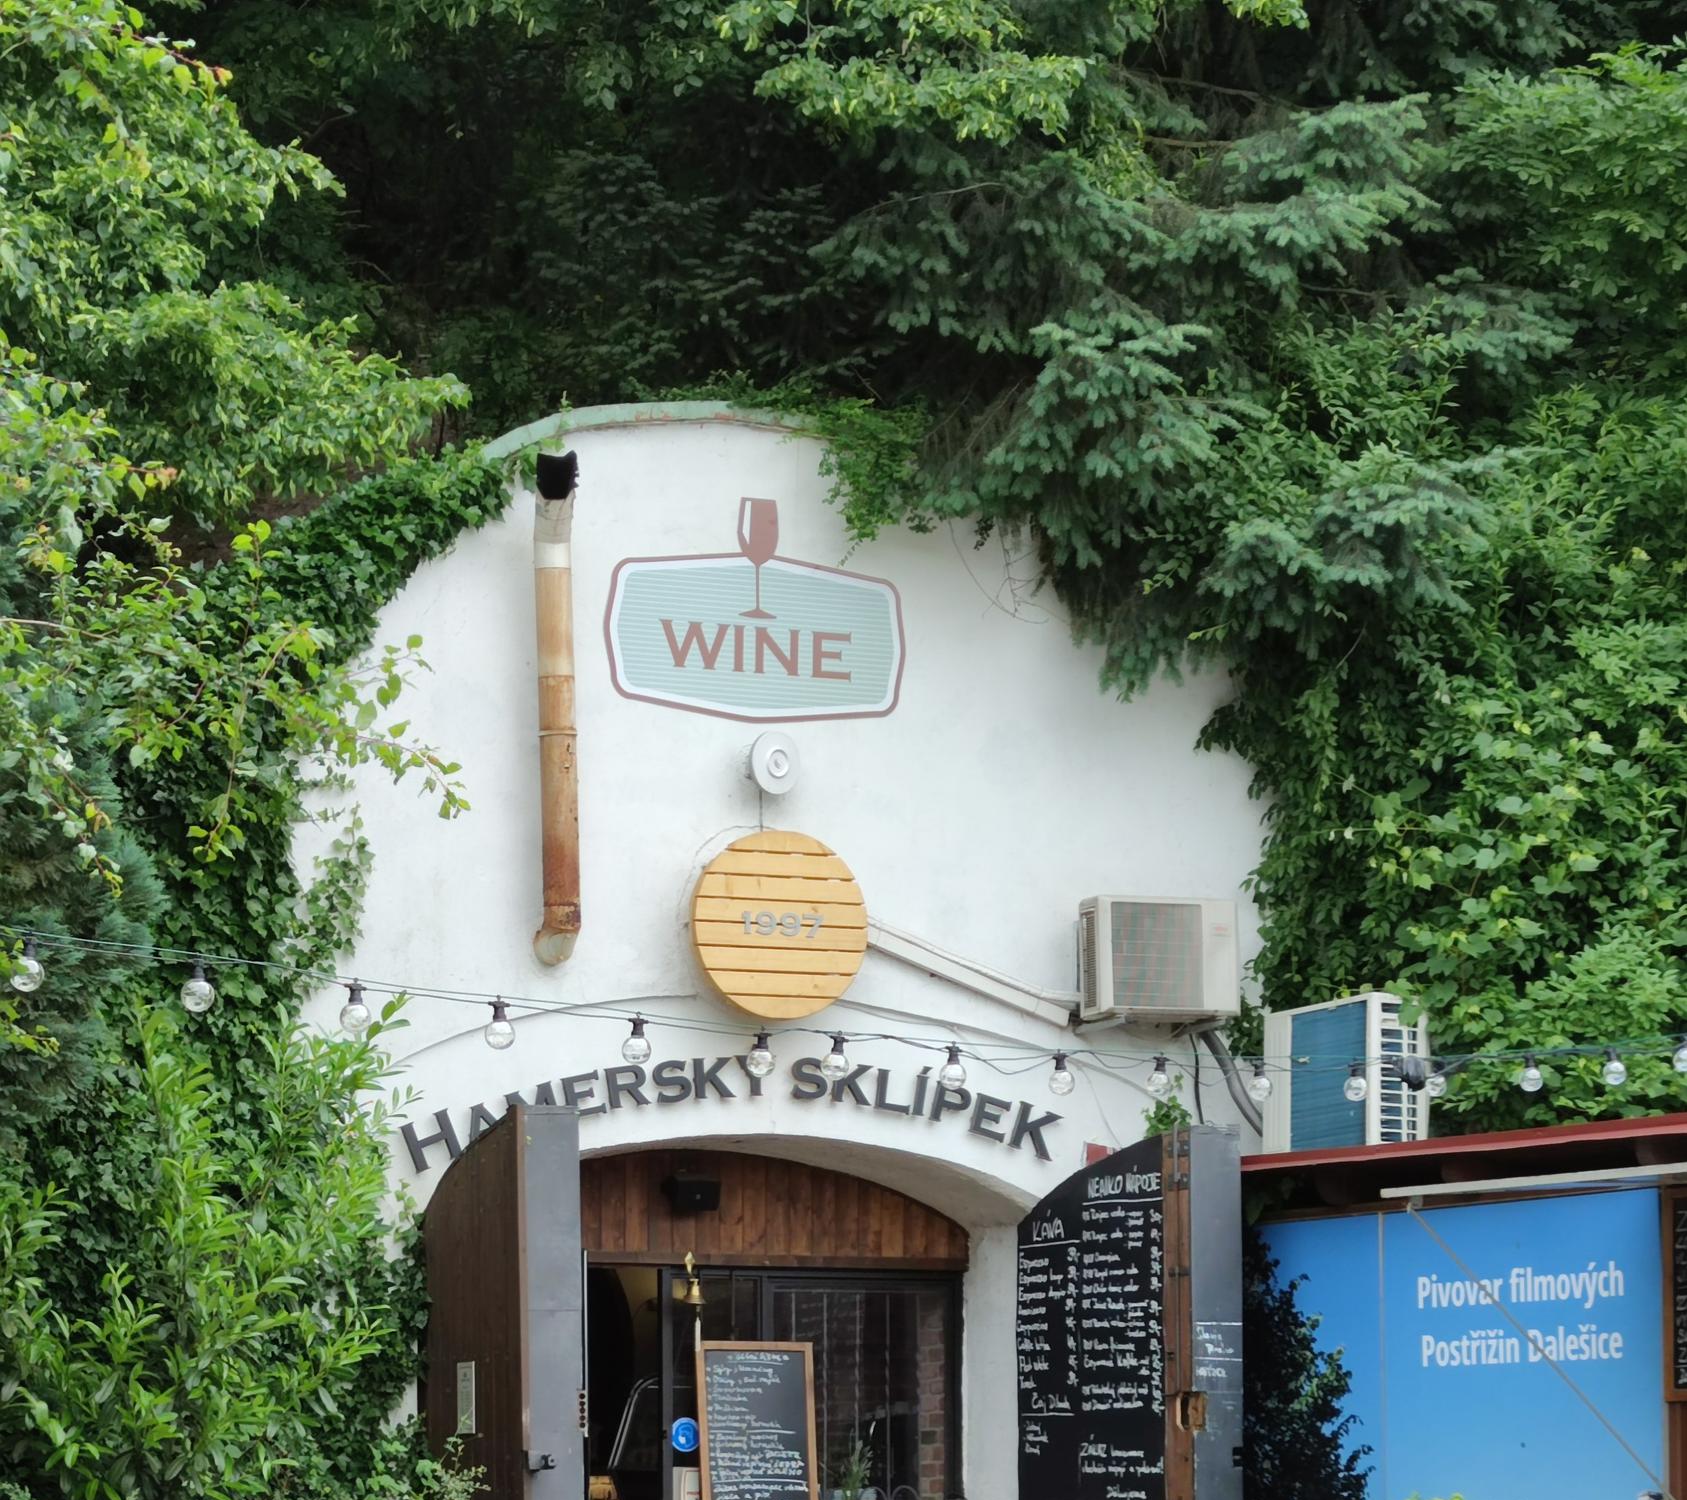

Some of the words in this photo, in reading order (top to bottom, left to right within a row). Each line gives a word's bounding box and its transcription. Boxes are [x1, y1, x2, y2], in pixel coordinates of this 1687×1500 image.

[659, 618, 852, 683] WINE
[742, 910, 824, 938] 1997
[791, 1057, 1065, 1162] SKLÍPEK
[1032, 1209, 1065, 1241] KÁVA
[1417, 1274, 1504, 1309] Pivovar
[1509, 1260, 1625, 1309] filmových
[1421, 1329, 1521, 1367] Postřižin
[1527, 1322, 1624, 1363] Dalešice
